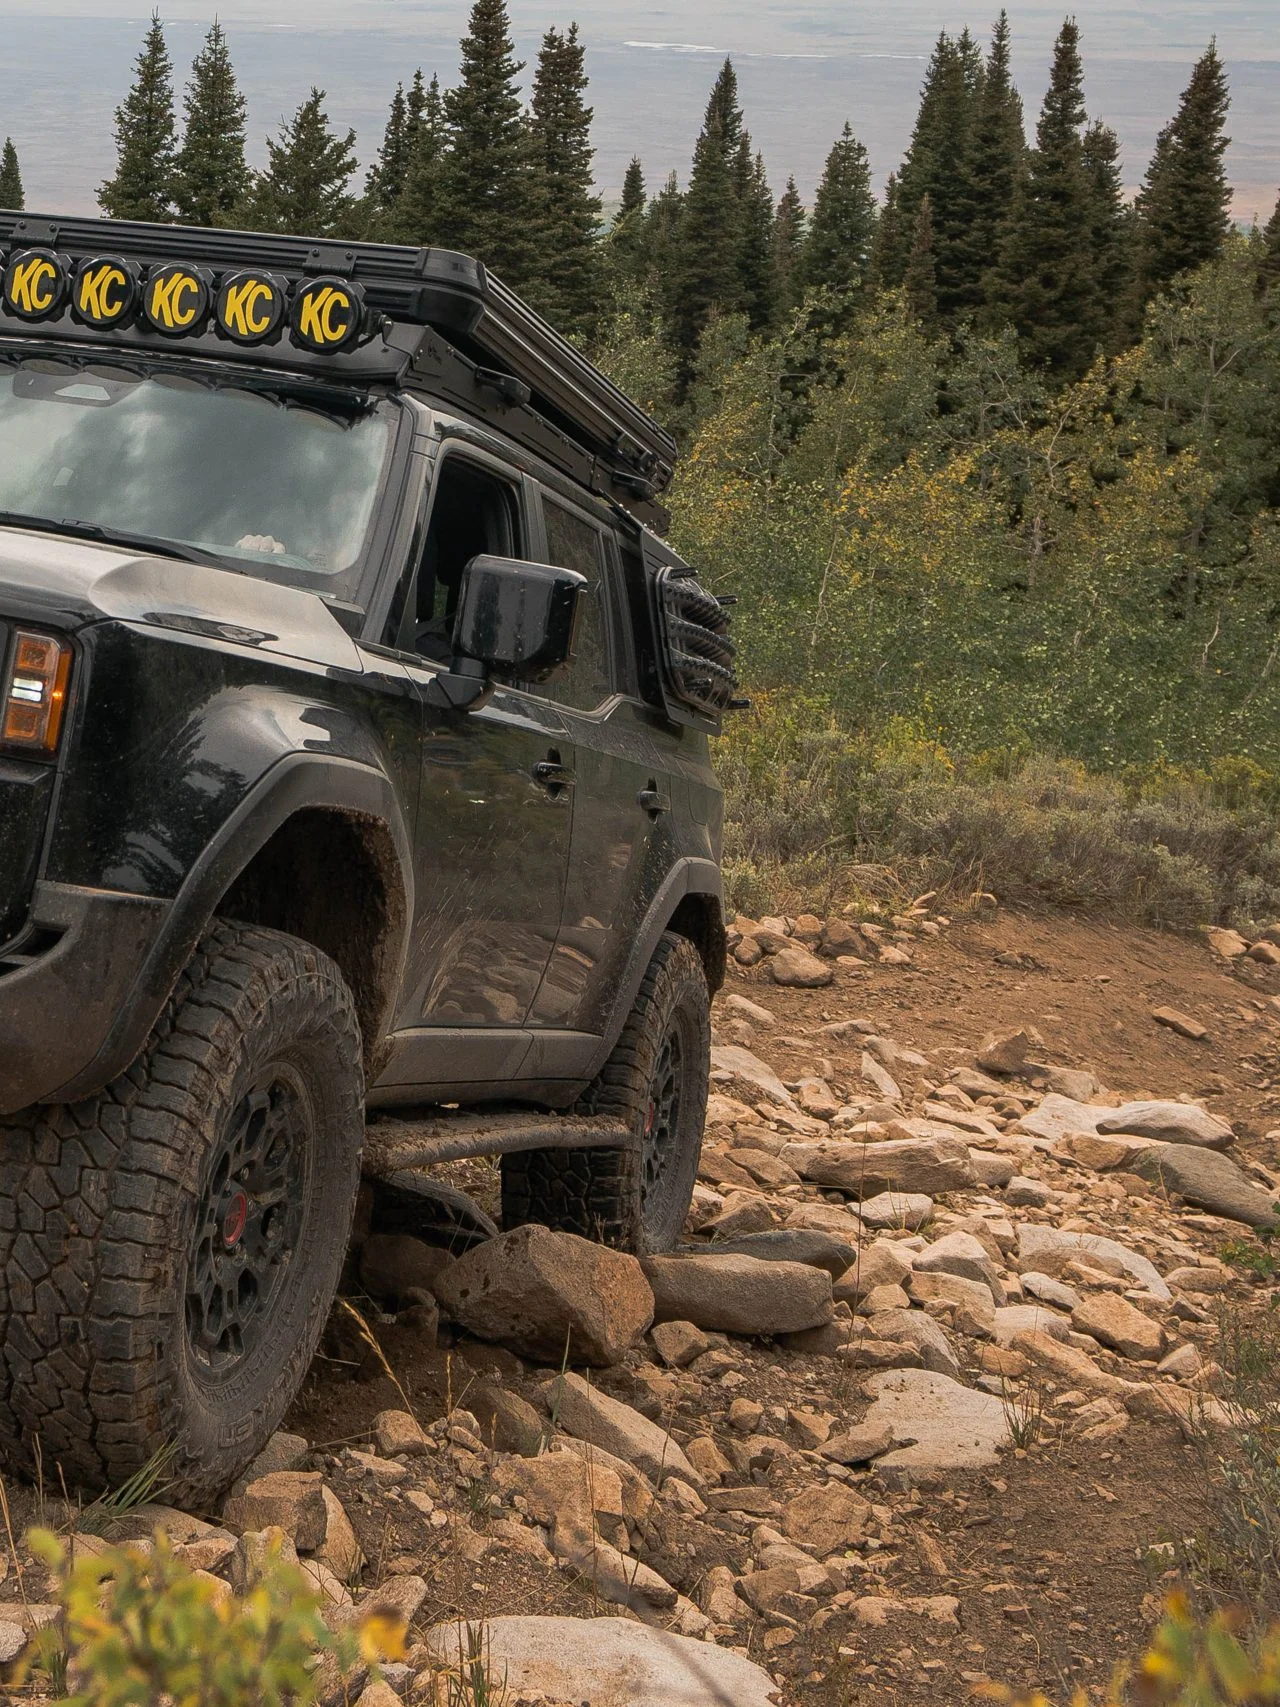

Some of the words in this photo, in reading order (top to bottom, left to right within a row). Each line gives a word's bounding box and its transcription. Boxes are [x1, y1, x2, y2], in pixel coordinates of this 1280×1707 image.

[11, 258, 56, 310] KC
[79, 265, 126, 320] KC
[151, 272, 198, 327] KC
[224, 280, 273, 335] KC
[300, 287, 350, 344] KC
